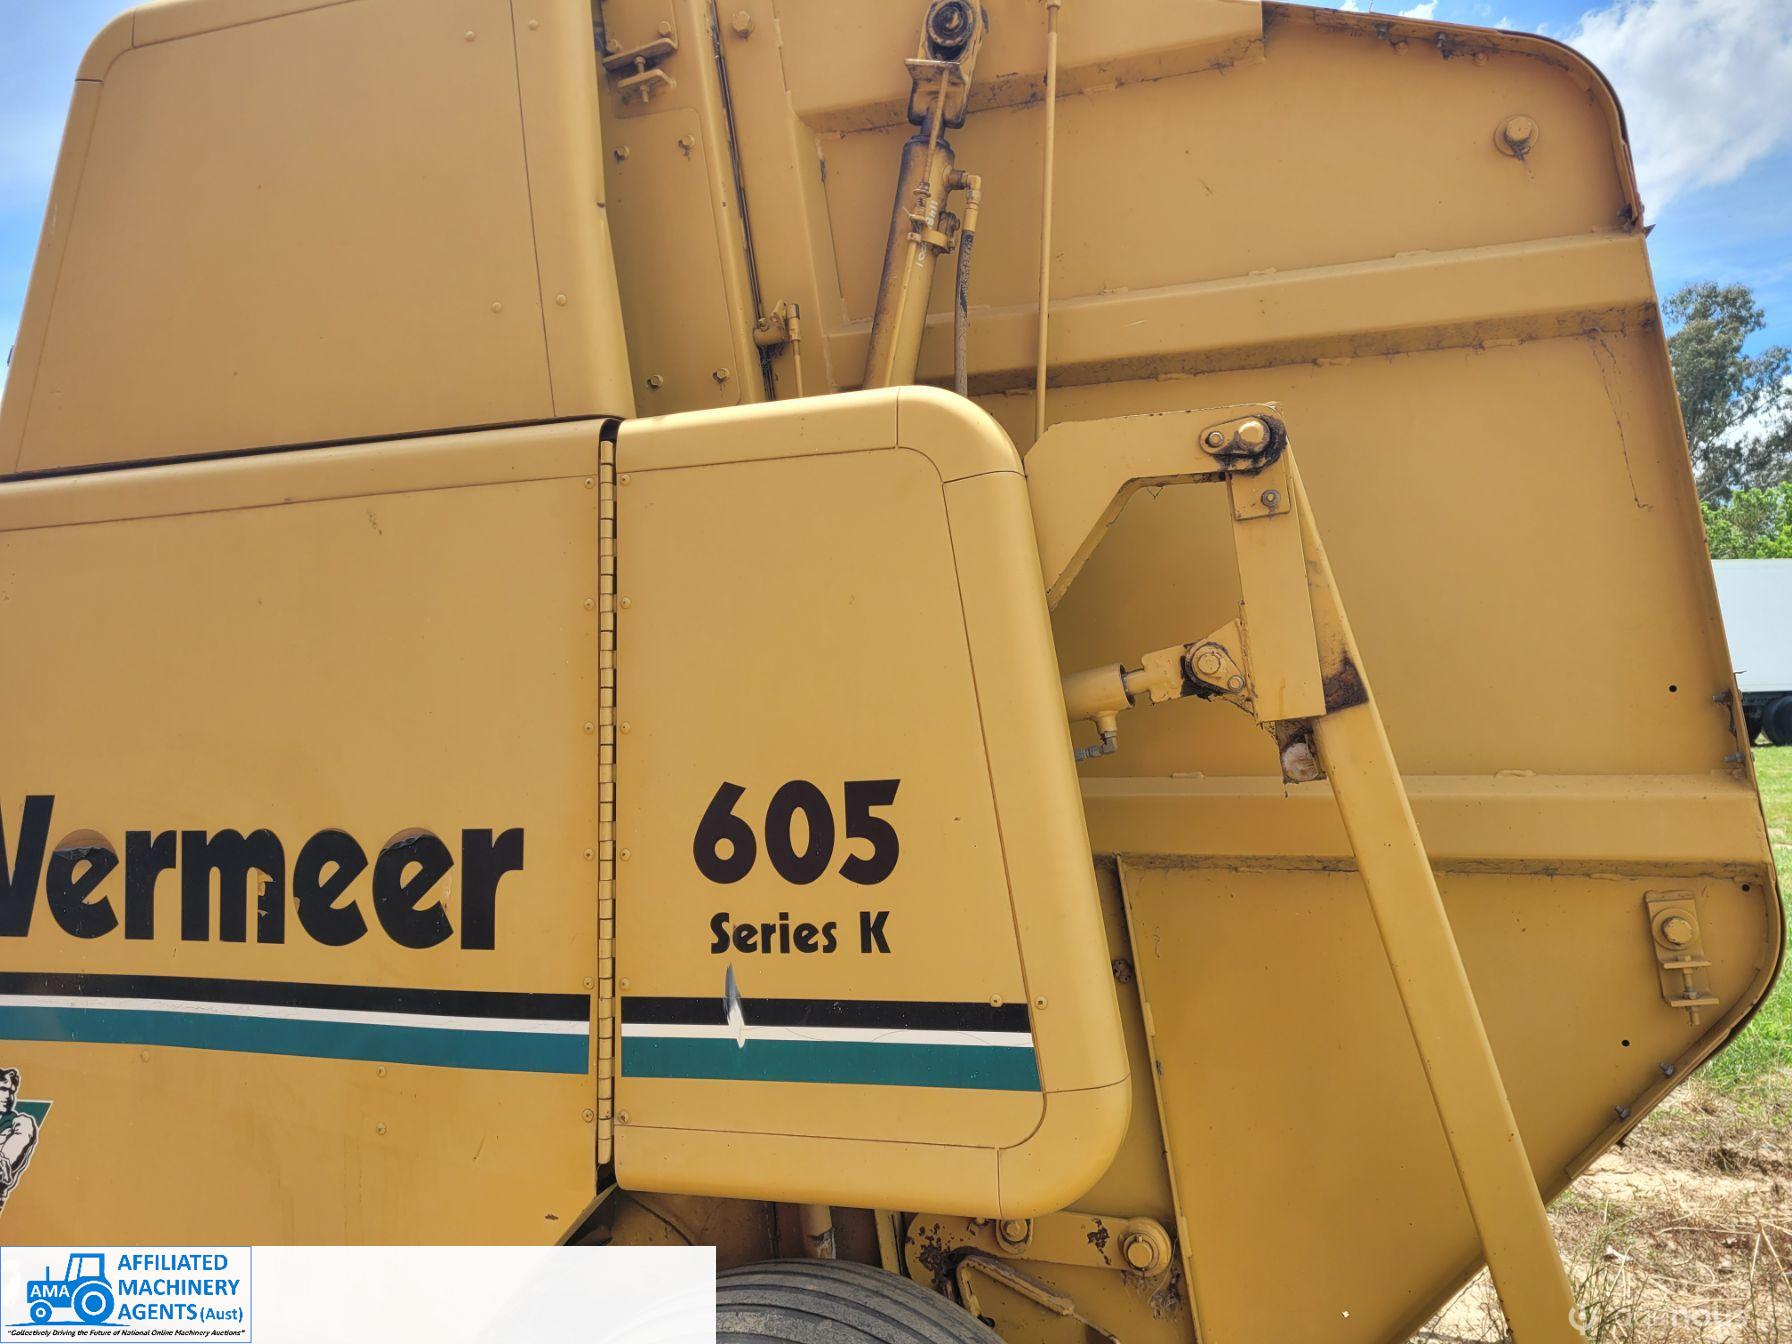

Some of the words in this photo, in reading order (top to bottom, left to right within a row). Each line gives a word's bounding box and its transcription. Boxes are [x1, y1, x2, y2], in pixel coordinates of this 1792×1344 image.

[0, 794, 524, 950] Vermeer
[693, 778, 901, 885] 605
[710, 911, 837, 954] Series
[859, 911, 891, 953] K
